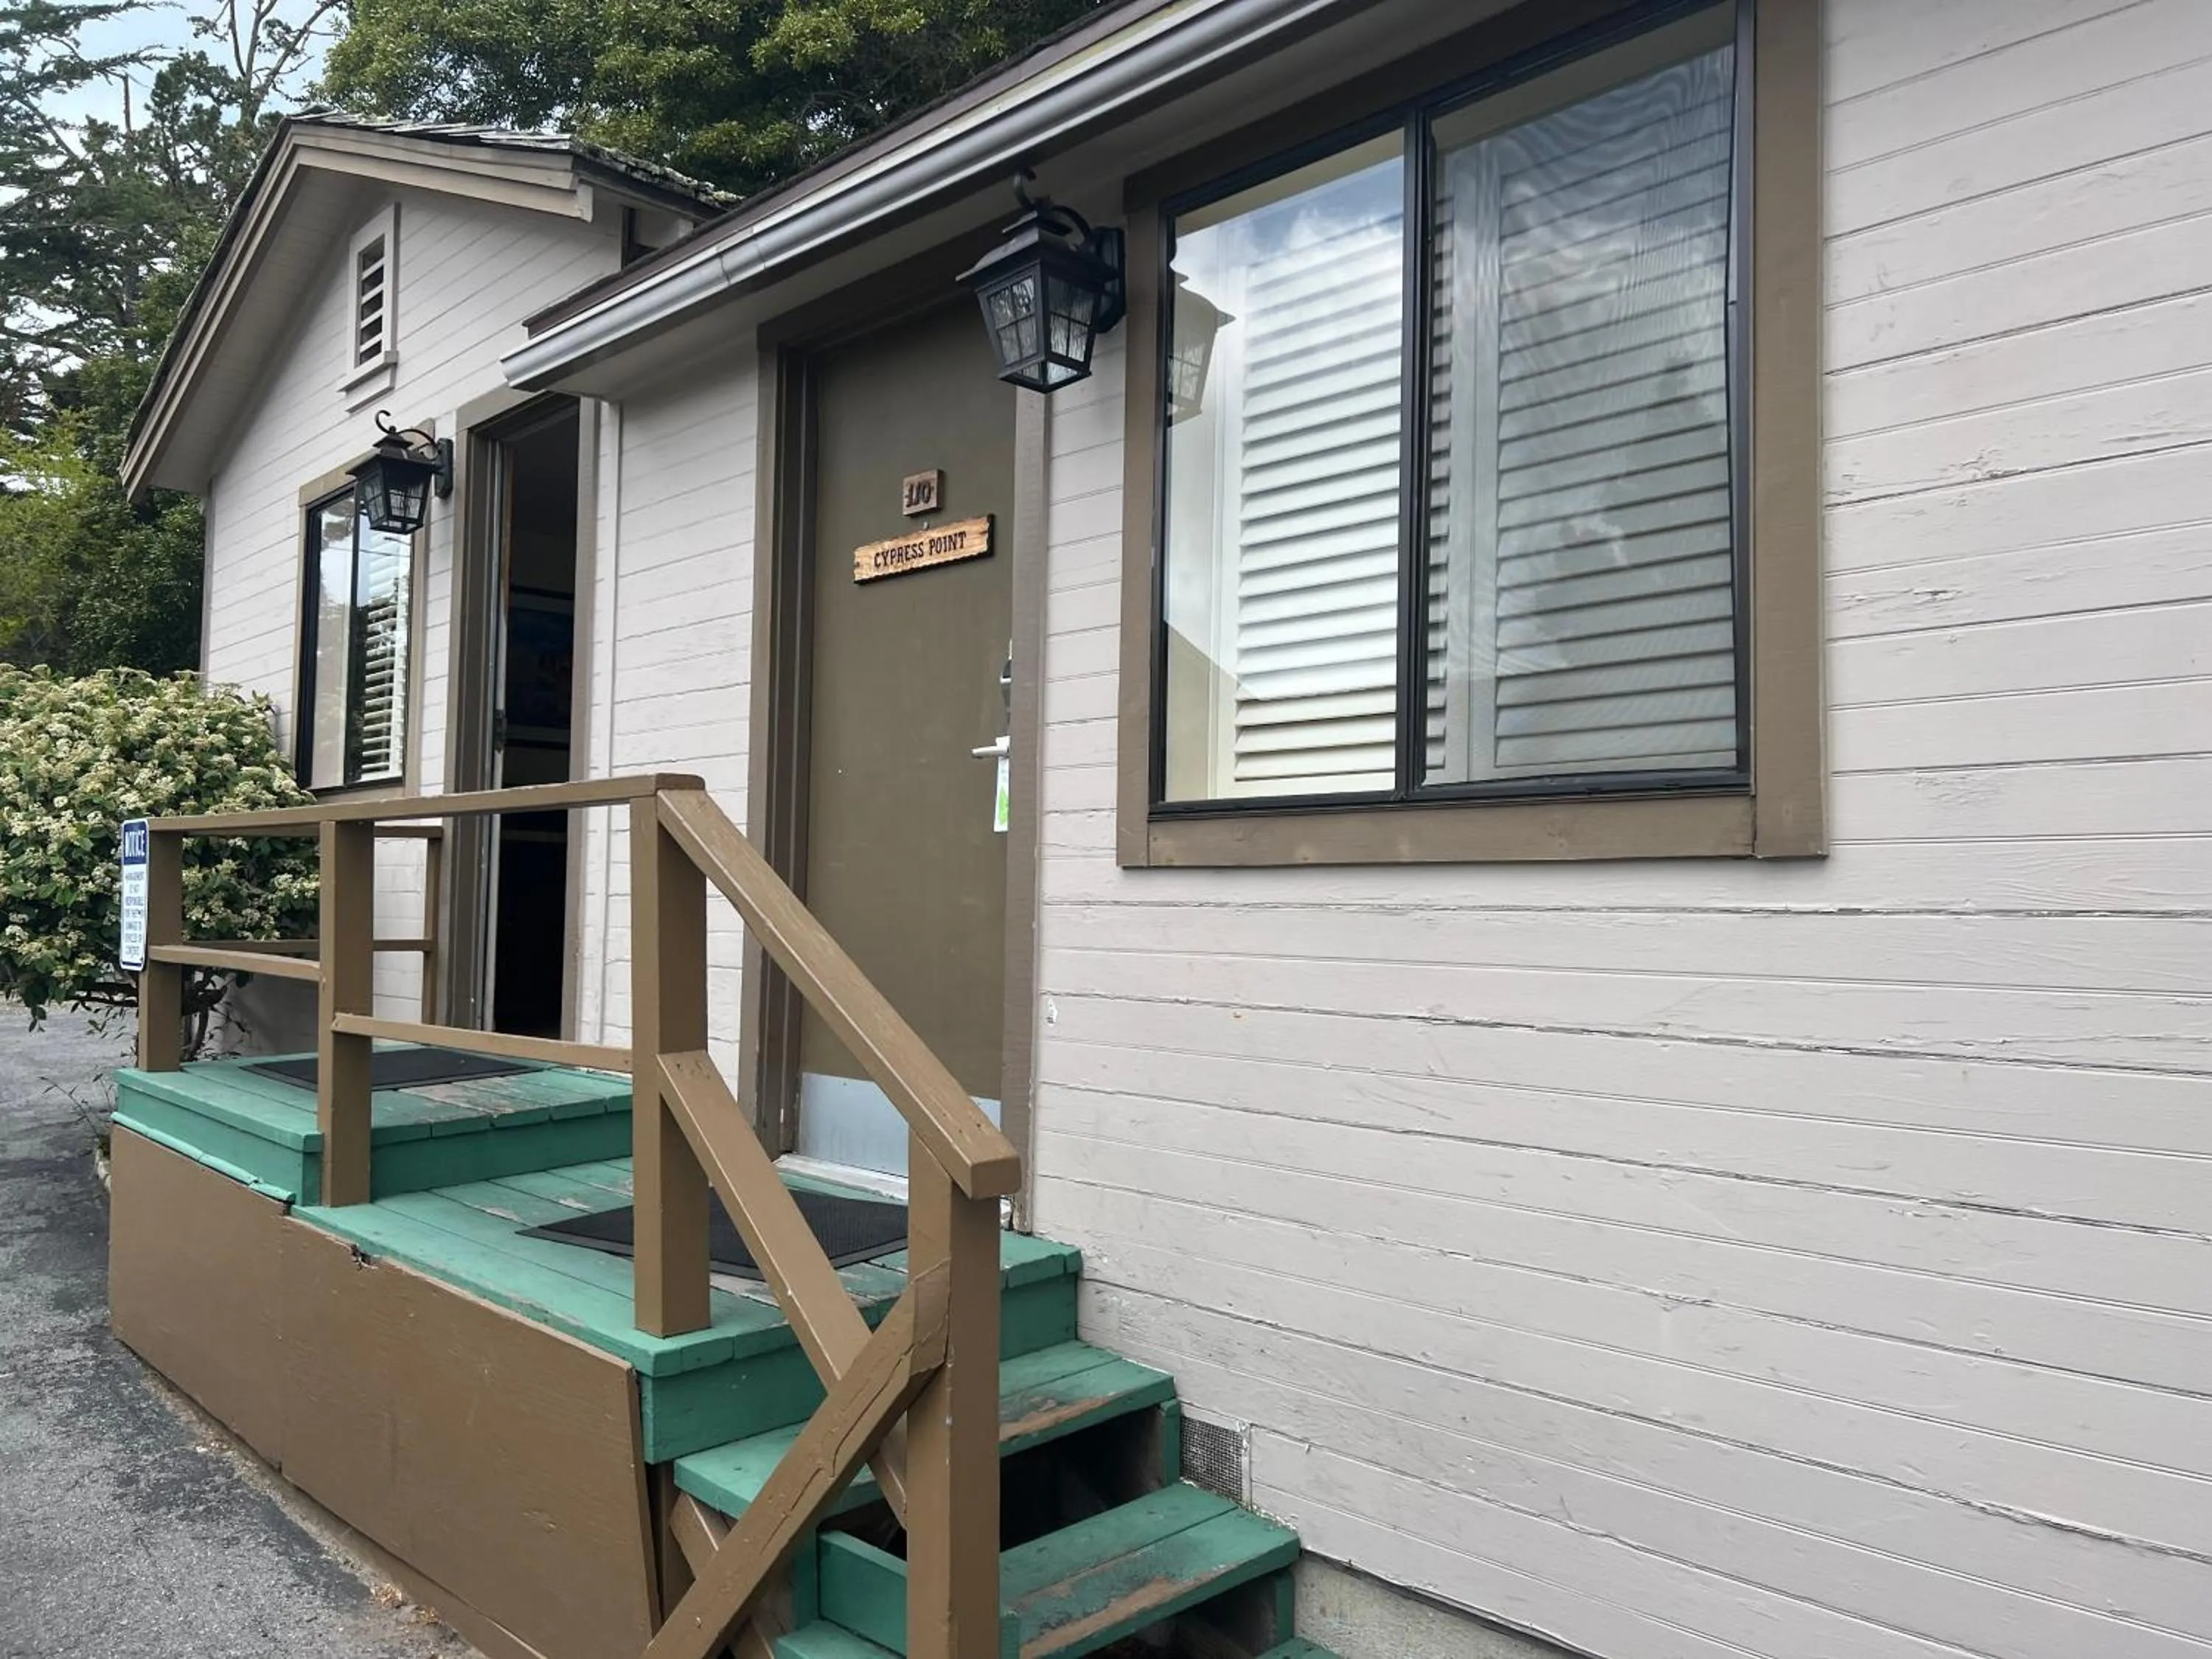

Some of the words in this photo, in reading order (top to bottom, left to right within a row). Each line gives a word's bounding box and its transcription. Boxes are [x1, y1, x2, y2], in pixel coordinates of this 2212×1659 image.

[905, 481, 931, 508] 110
[874, 540, 924, 568] CYPRESS
[929, 530, 967, 556] POINT
[125, 830, 145, 858] NOTICE
